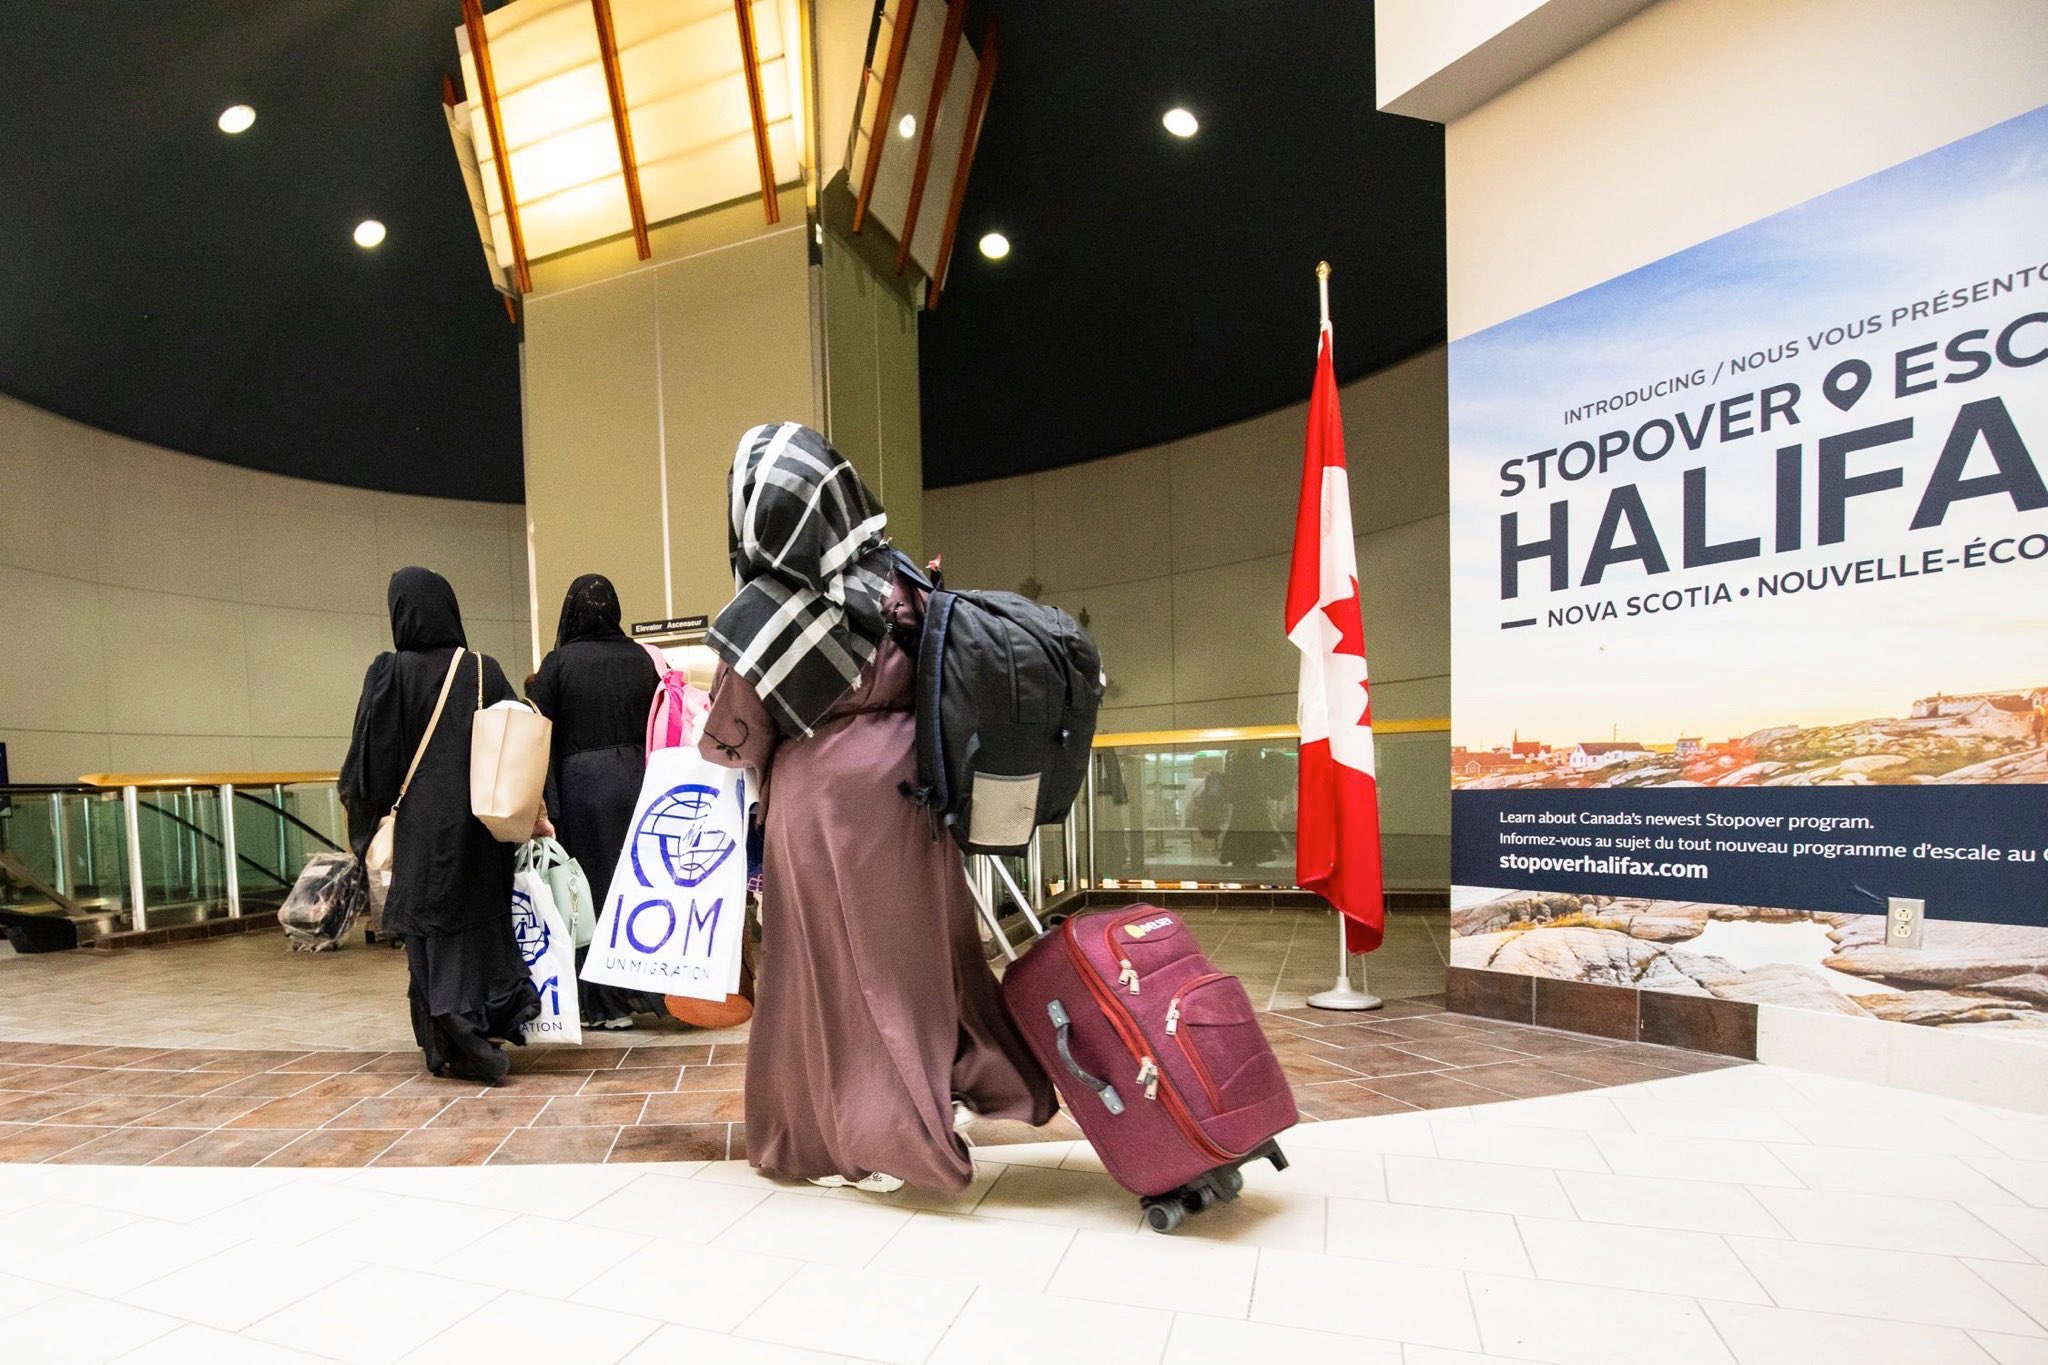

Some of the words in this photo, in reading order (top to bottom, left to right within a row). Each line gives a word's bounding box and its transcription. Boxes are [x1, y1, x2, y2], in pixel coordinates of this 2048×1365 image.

[1564, 368, 1706, 425] INTRODUCING
[1730, 340, 1800, 376] NOUS
[1807, 314, 1883, 351] VOUS
[1500, 382, 1802, 497] STOPOVER
[1895, 311, 2048, 399] ESC
[1500, 396, 2048, 600] HALIFA
[635, 623, 663, 633] Elevator
[666, 619, 702, 629] Ascenseur
[1547, 600, 1618, 628] NOVA
[1626, 582, 1732, 616] SCOTIA
[1500, 811, 1536, 824] Learn
[1538, 812, 1577, 825] about
[1579, 811, 1642, 826] Canada’s
[1645, 813, 1702, 826] newest
[1706, 812, 1784, 830] Stopover
[1788, 816, 1875, 832] program.
[1499, 853, 1709, 879] stopoverhalifax.com
[1500, 832, 1592, 848] Informez-vous
[1595, 837, 1612, 848] au
[1615, 836, 1652, 852] sujet
[1654, 836, 1674, 850] du
[1678, 838, 1712, 851] tout
[1716, 840, 1788, 854] nouveau
[1793, 842, 1907, 859] programme
[1912, 843, 2001, 861] d’escale
[2007, 848, 2036, 862] au
[609, 894, 724, 958] IOM
